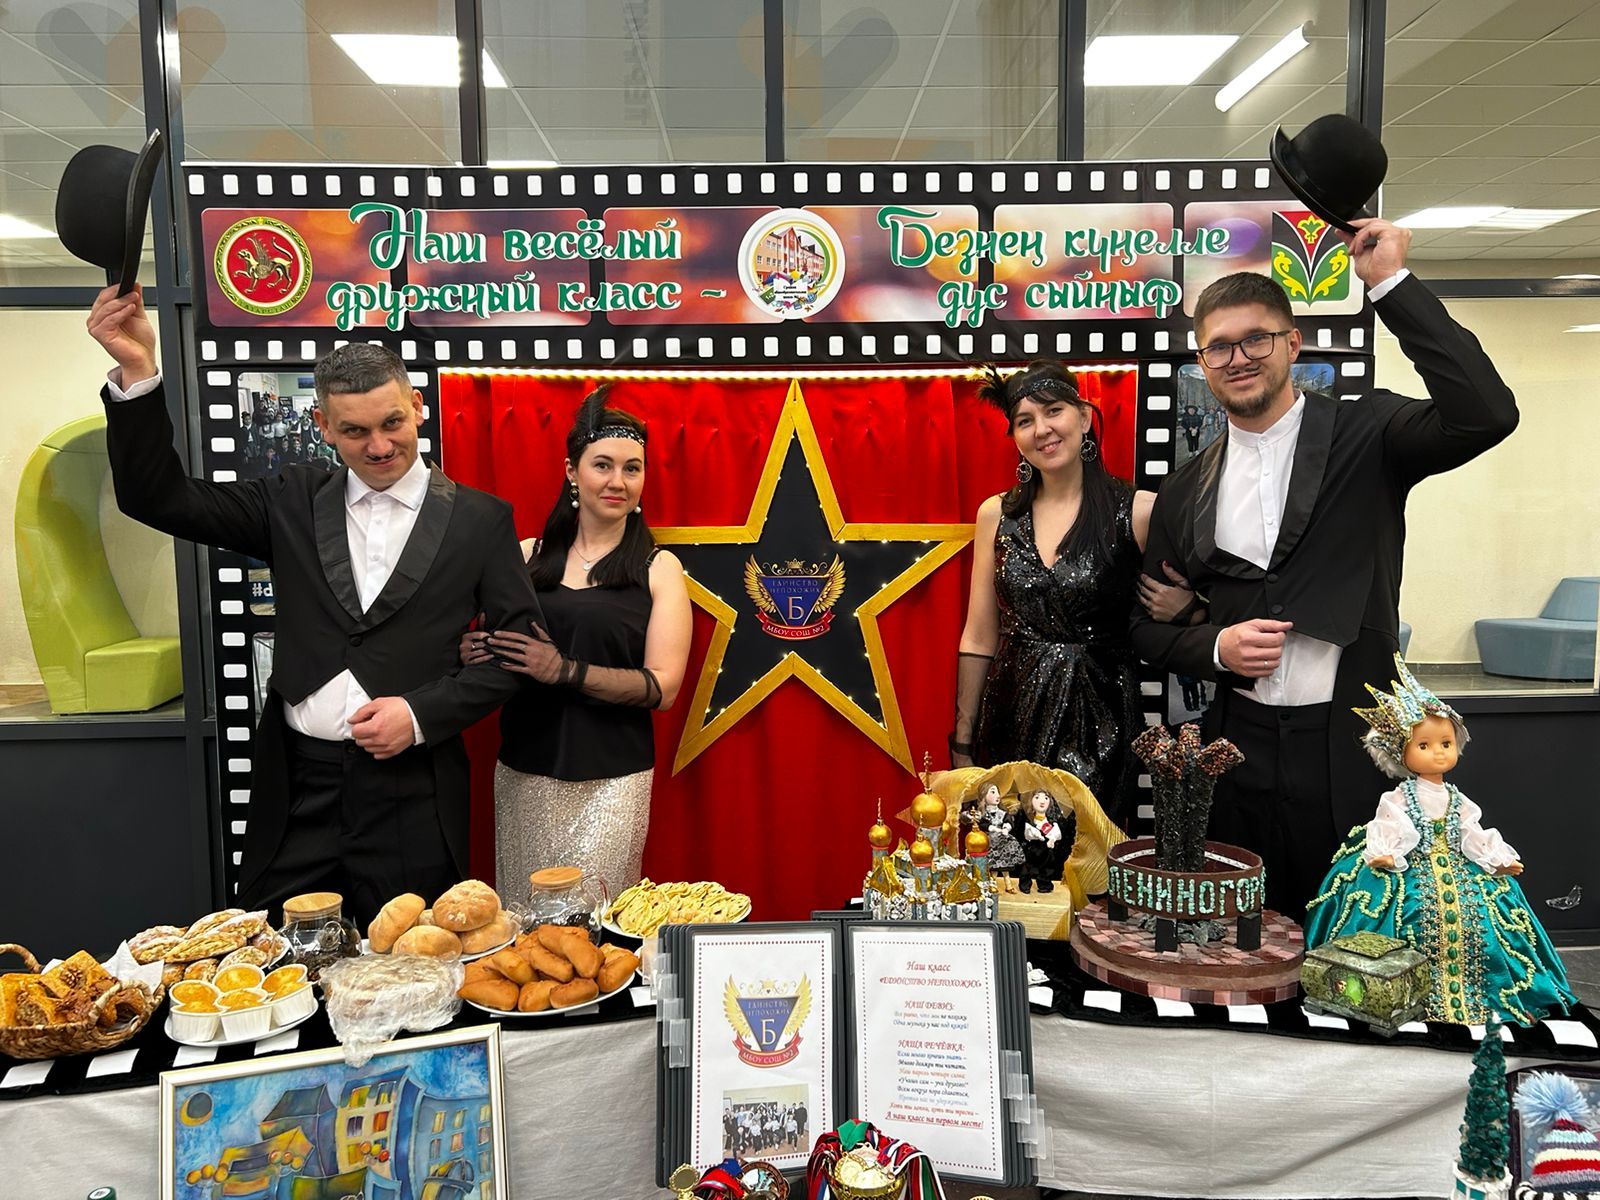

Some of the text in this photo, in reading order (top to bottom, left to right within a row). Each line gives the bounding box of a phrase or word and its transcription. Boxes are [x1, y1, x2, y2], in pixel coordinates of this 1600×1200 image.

[349, 202, 682, 270] Наш весёлый
[876, 205, 1230, 275] Безнең күңелле
[326, 271, 541, 331] дружный
[557, 282, 682, 313] класс
[937, 270, 1183, 328] дус сыйныф
[787, 596, 805, 620] Б
[766, 625, 788, 636] МБОУ
[790, 629, 811, 637] СОШ
[906, 961, 951, 973] Наш класс
[904, 1000, 955, 1011] НАШ ДЕВИЗ:
[760, 1018, 776, 1045] Б
[897, 1040, 923, 1048] НАША
[742, 1051, 763, 1062] МБОУ
[885, 1111, 892, 1120] А
[935, 1117, 959, 1126] первом
[960, 1120, 984, 1128] месте!
